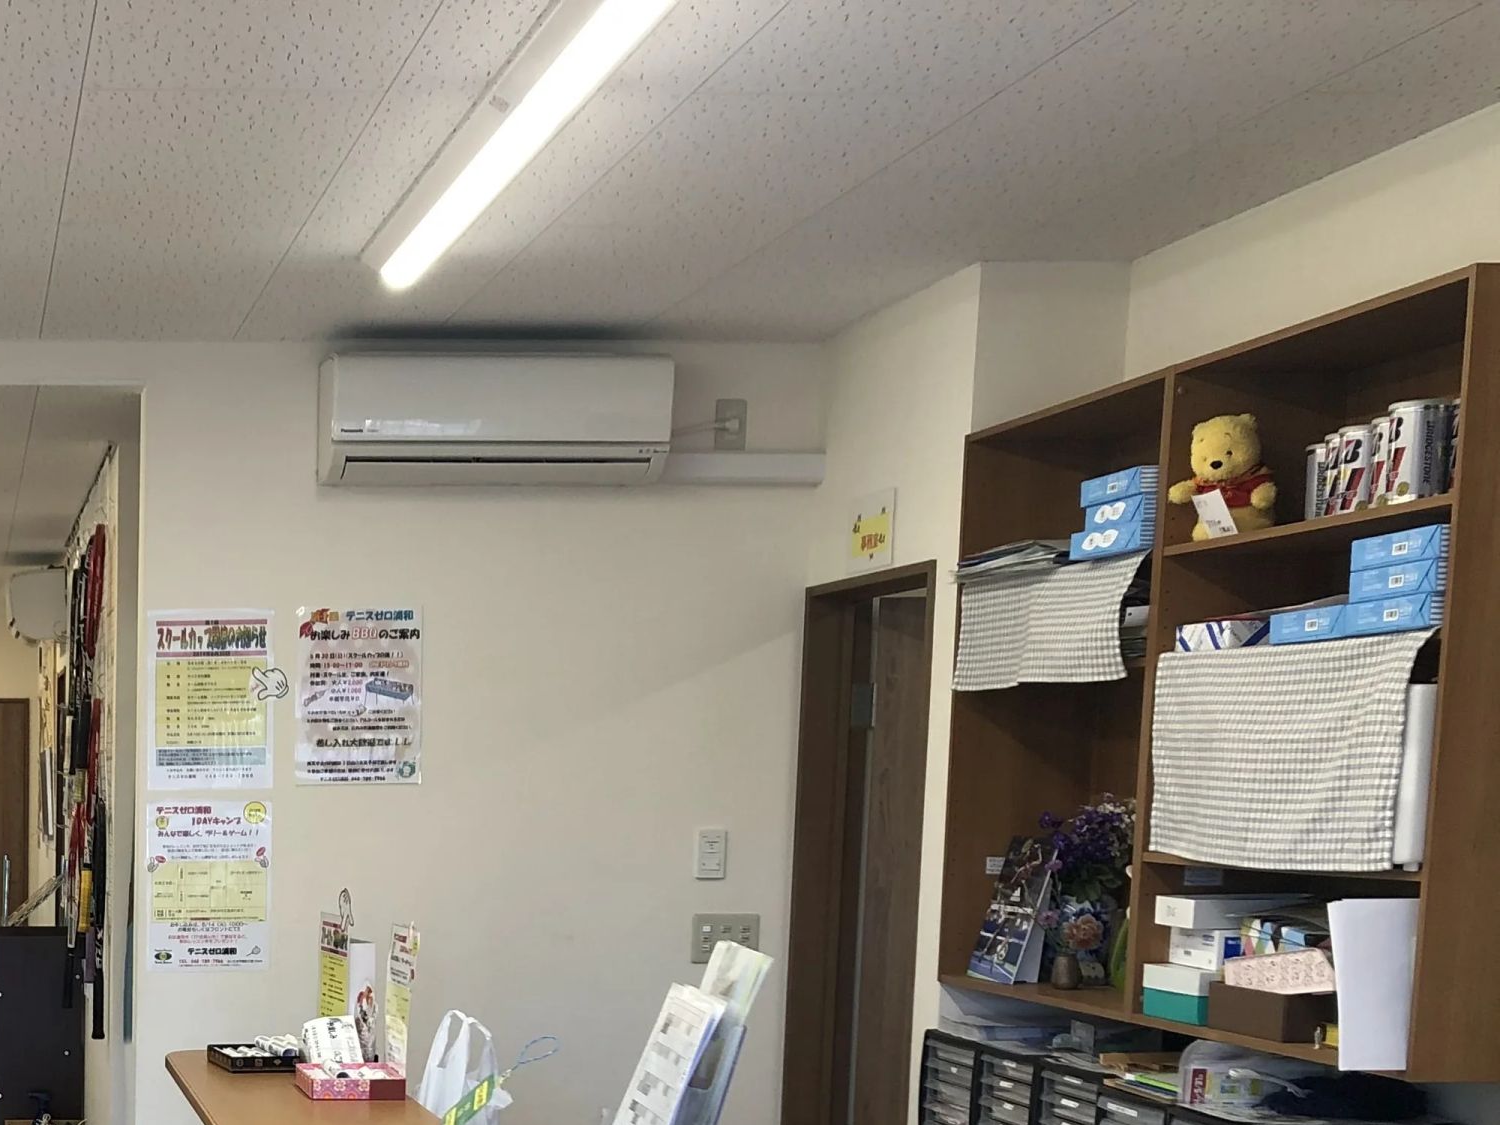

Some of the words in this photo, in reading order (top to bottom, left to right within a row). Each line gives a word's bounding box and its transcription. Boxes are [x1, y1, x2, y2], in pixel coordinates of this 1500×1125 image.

[346, 610, 414, 621] テニスゼロ浦和
[156, 806, 212, 815] テニスゼロ浦和
[188, 947, 238, 955] テニスゼロ浦和
